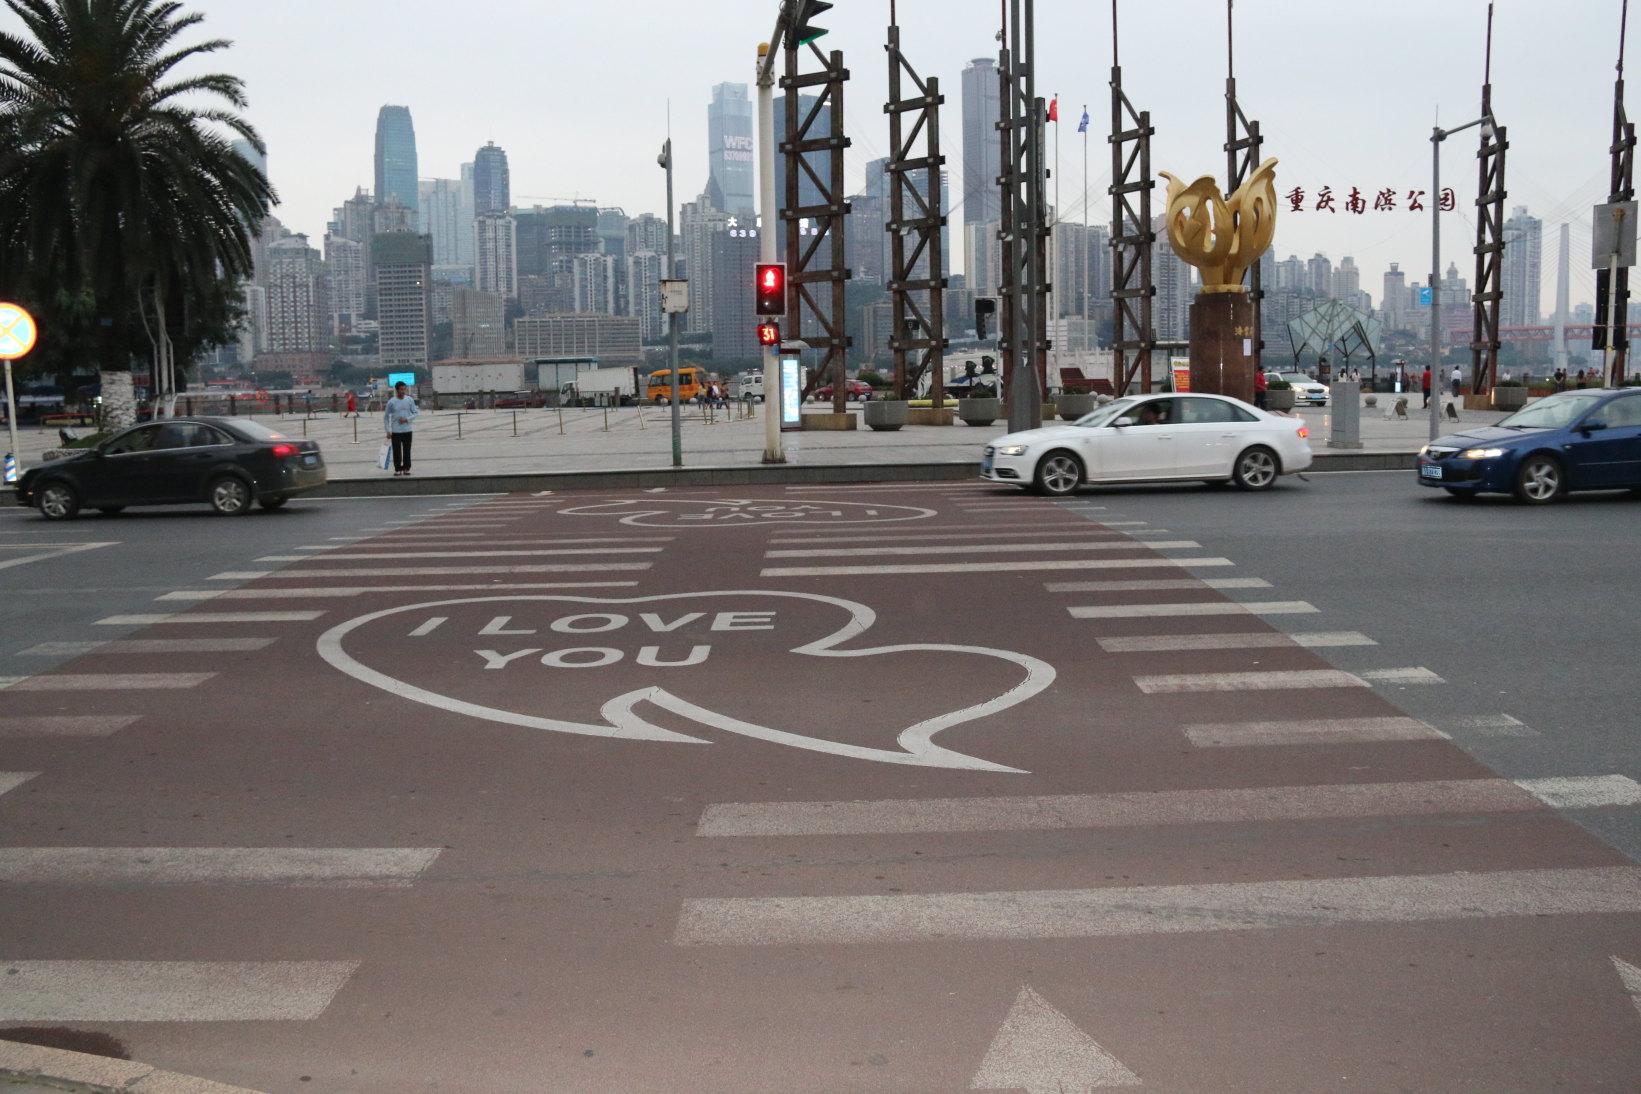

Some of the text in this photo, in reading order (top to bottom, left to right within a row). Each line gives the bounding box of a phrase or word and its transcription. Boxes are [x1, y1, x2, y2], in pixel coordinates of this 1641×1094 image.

[1284, 185, 1456, 215] 重庆南滨公园
[761, 328, 775, 341] 31
[407, 611, 777, 637] I LOVE
[472, 645, 712, 670] YOU
